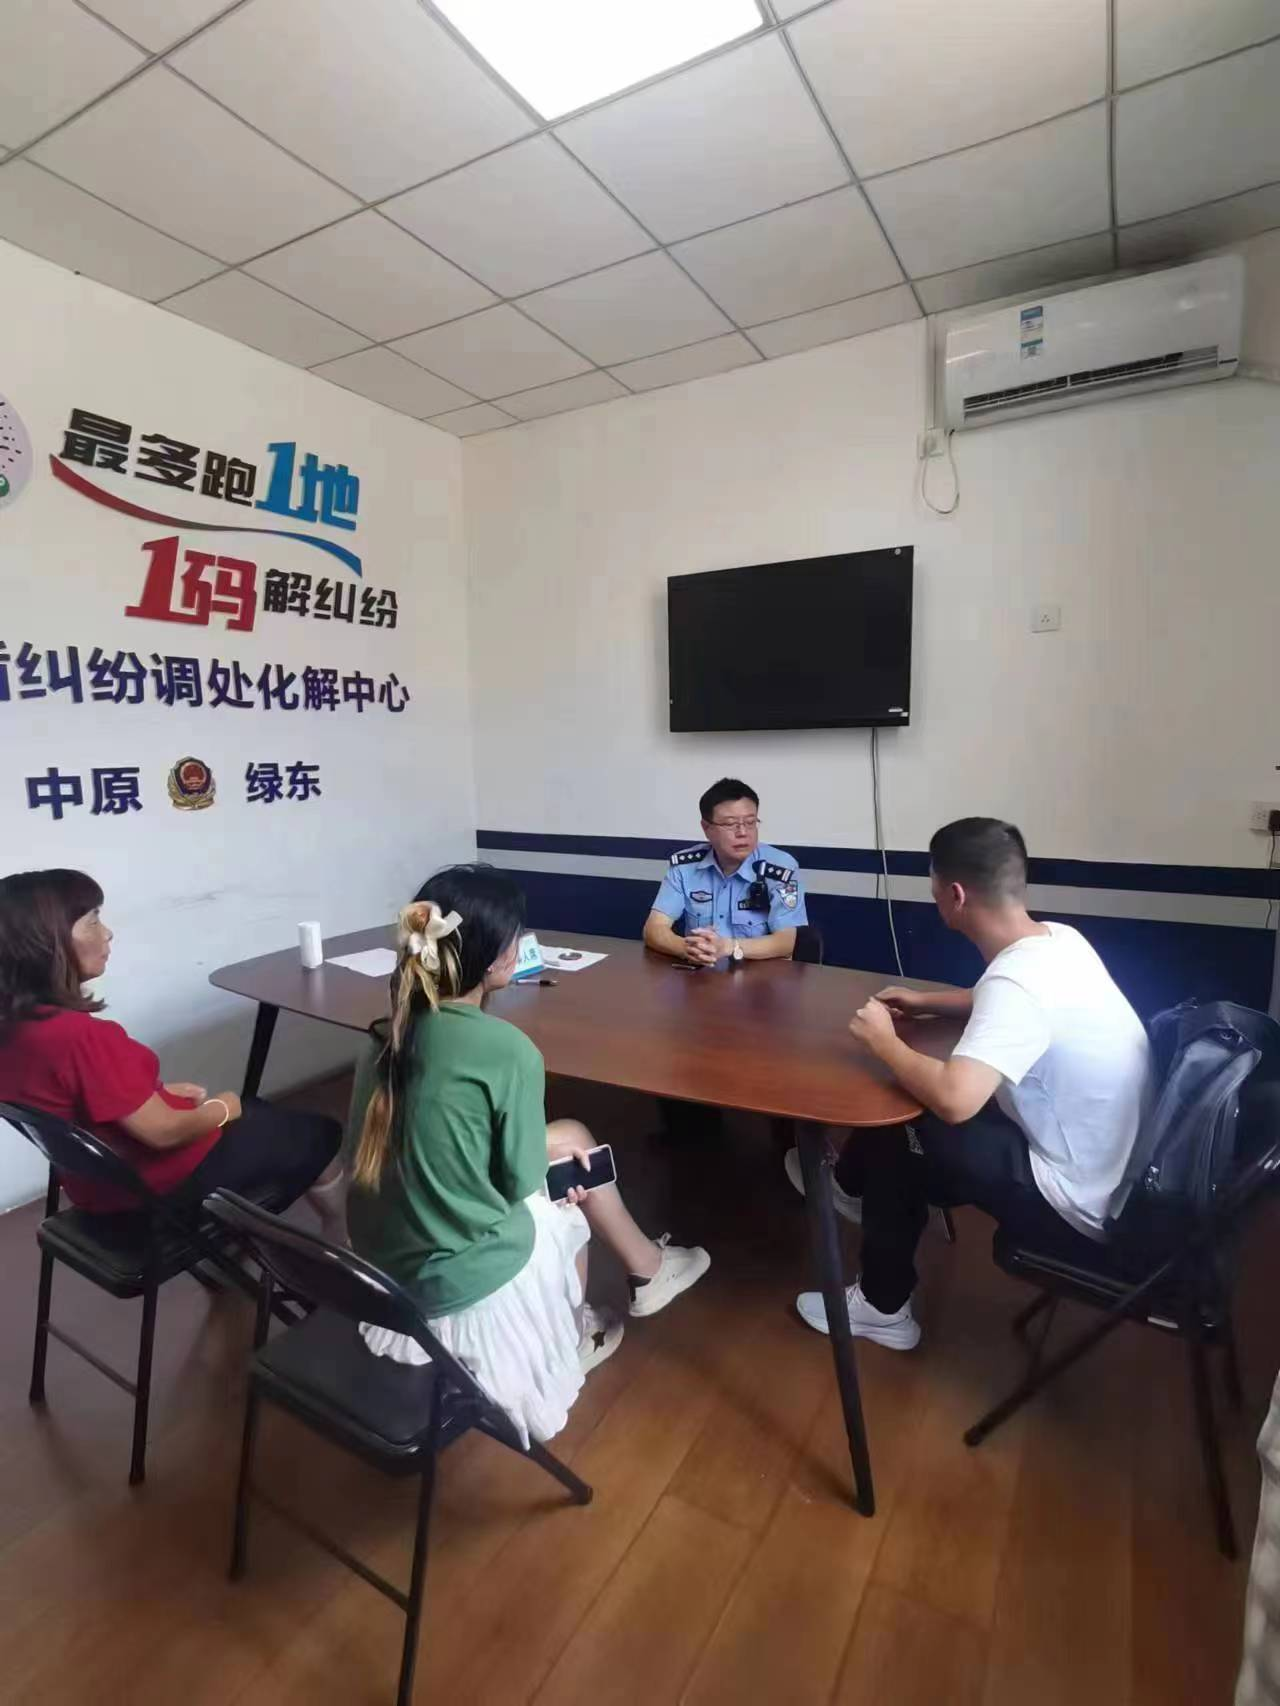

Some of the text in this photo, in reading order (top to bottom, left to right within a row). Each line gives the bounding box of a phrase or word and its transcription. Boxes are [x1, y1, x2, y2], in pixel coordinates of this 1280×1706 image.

[59, 408, 360, 531] 最多跑1地
[124, 535, 399, 632] 1码解纠纷
[26, 761, 322, 820] 中原 绿东
